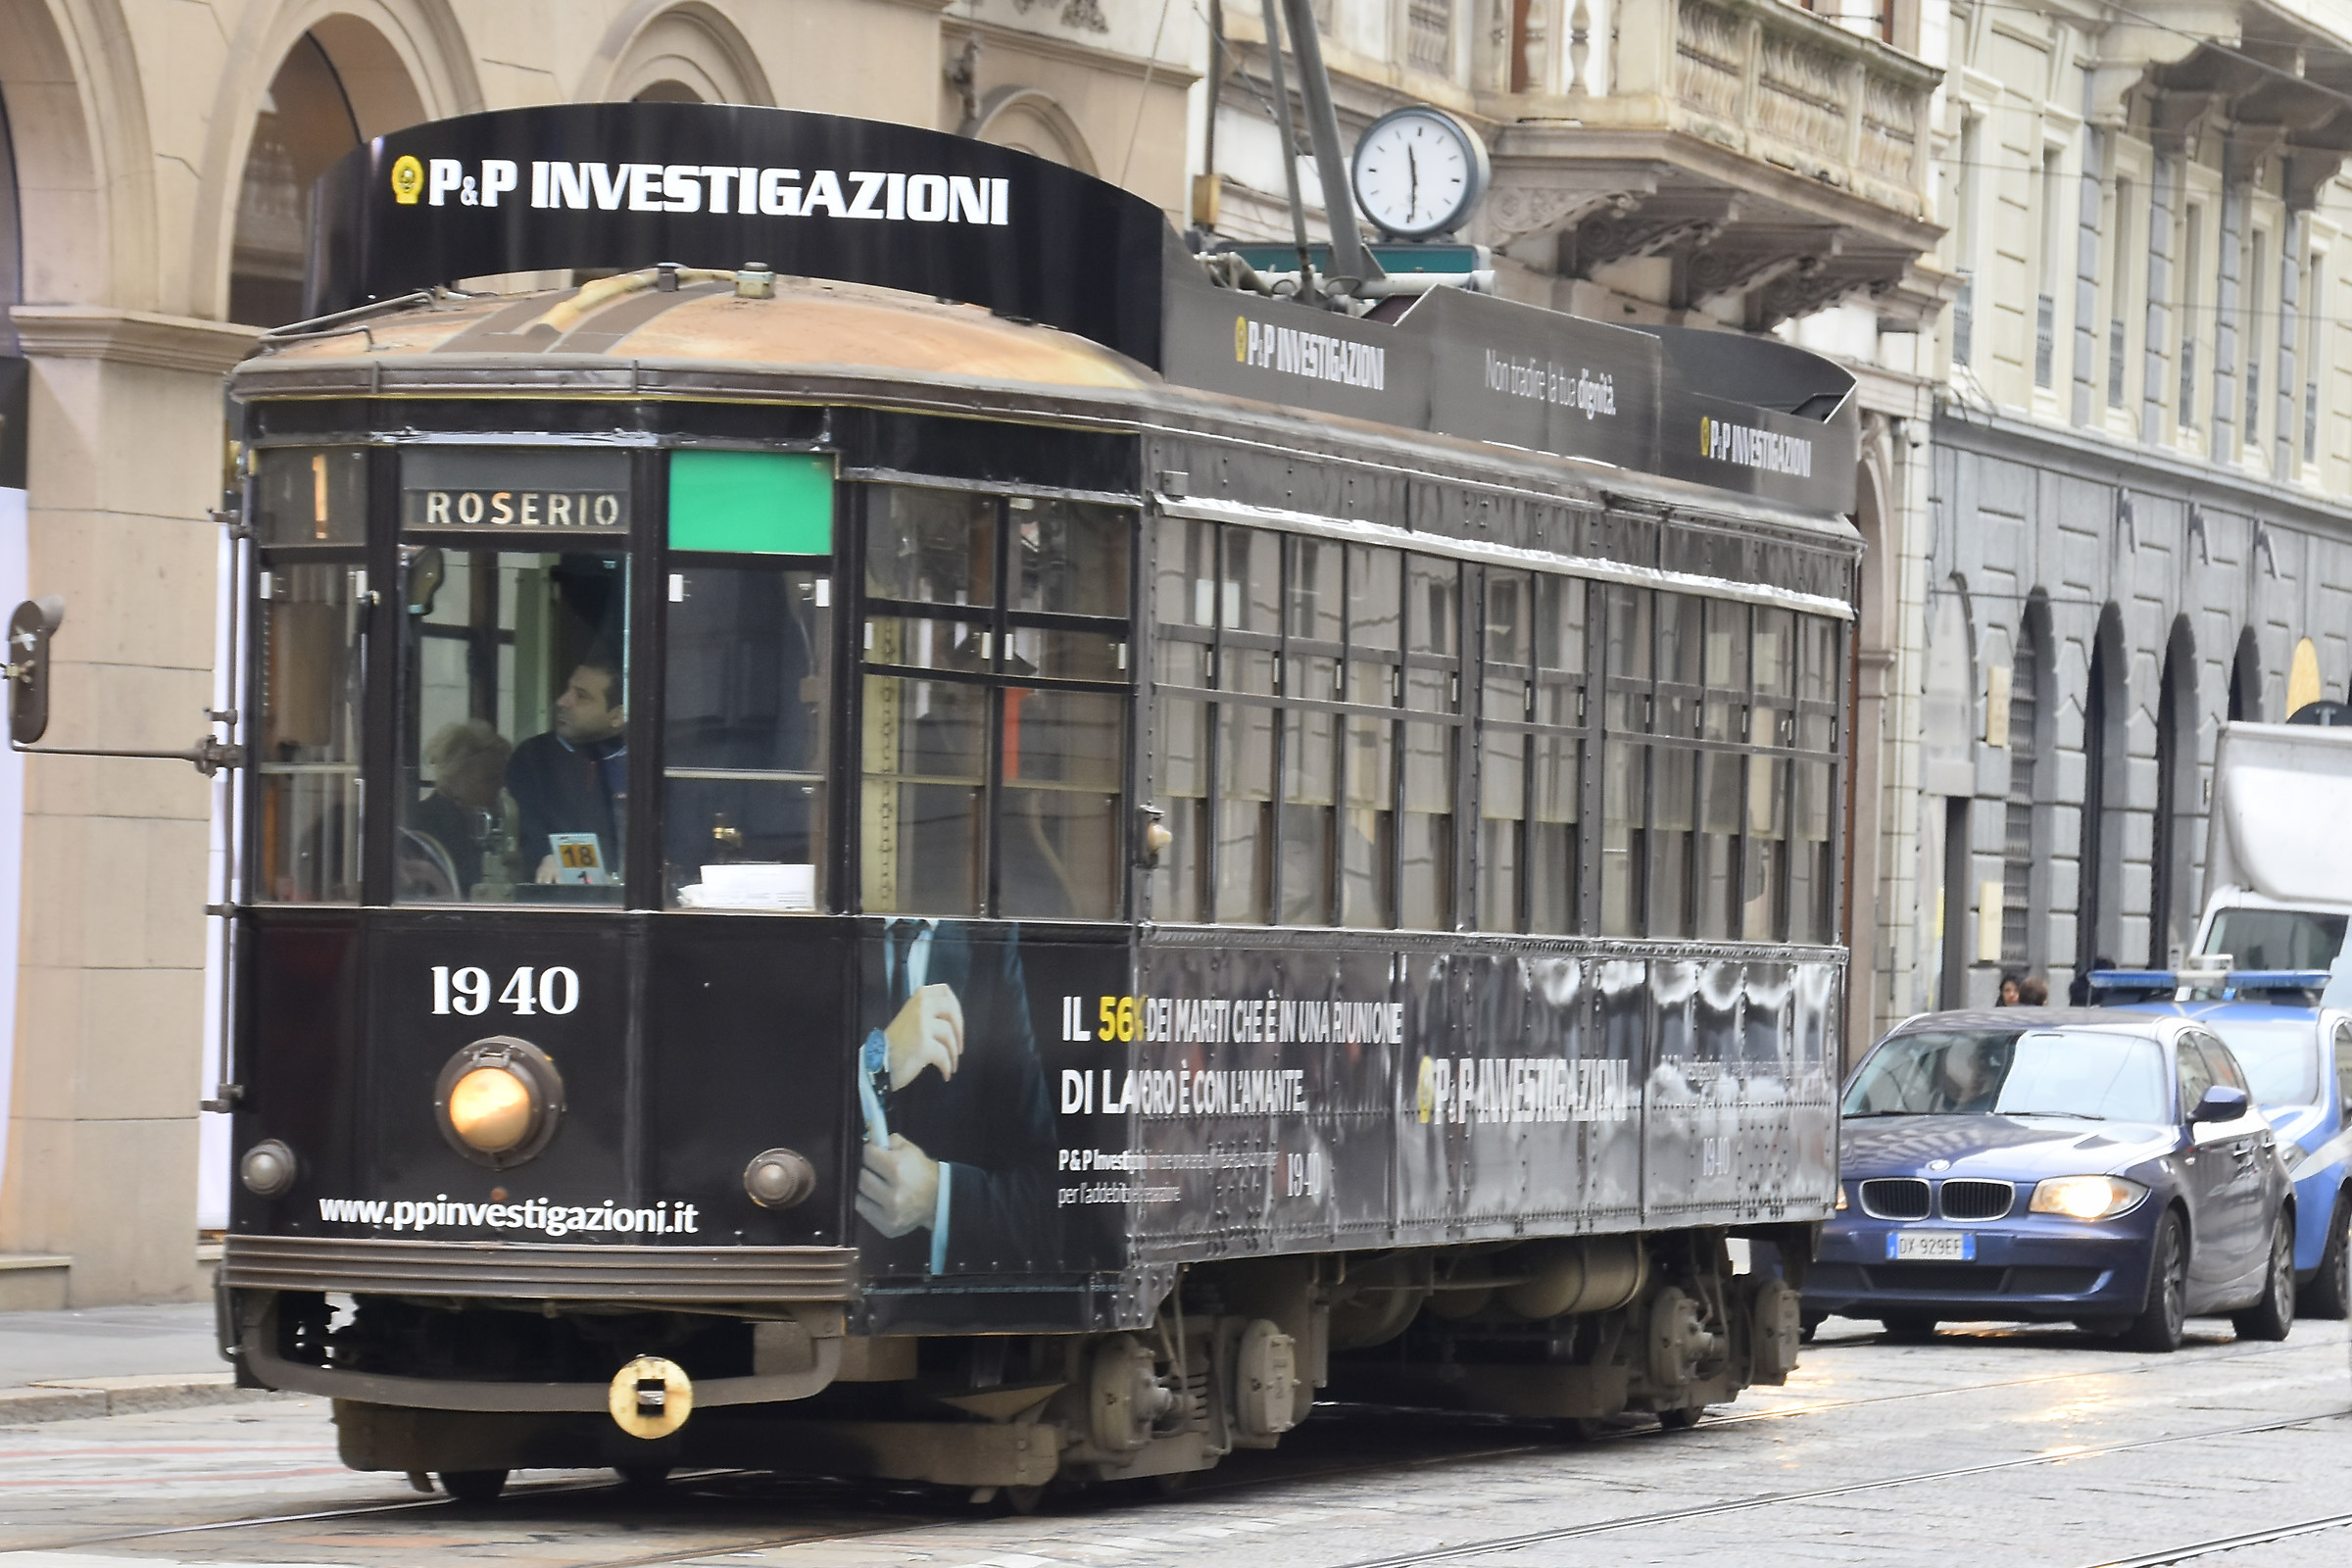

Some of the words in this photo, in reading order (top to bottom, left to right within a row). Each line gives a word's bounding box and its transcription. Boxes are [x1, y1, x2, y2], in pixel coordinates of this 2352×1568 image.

[427, 157, 517, 208] P&P
[530, 160, 1009, 226] INVESTIGAZIONI
[1276, 326, 1385, 391] INVESTIGAZIONI
[1485, 347, 1509, 392] Non
[1732, 424, 1811, 477] INVESTIGAZIONI
[425, 491, 619, 527] ROSERIO
[430, 964, 581, 1016] 1940
[1062, 996, 1092, 1042] IL
[1146, 998, 1173, 1043] DEI
[1175, 998, 1231, 1043] MARITI
[1232, 1000, 1264, 1044] CHE
[1264, 989, 1278, 1044] È
[1279, 1000, 1297, 1044] IN
[1298, 1001, 1331, 1044] UNA
[1332, 1002, 1403, 1045] RIUNIONE
[1060, 1069, 1094, 1115] DI
[1179, 1058, 1191, 1115] È
[1193, 1069, 1229, 1115] CON
[1477, 1058, 1629, 1124] INVESTIGAZIONI
[1058, 1149, 1093, 1171] P&P
[318, 1194, 699, 1238] www.ppinvestigazioni.it
[1057, 1188, 1079, 1208] per
